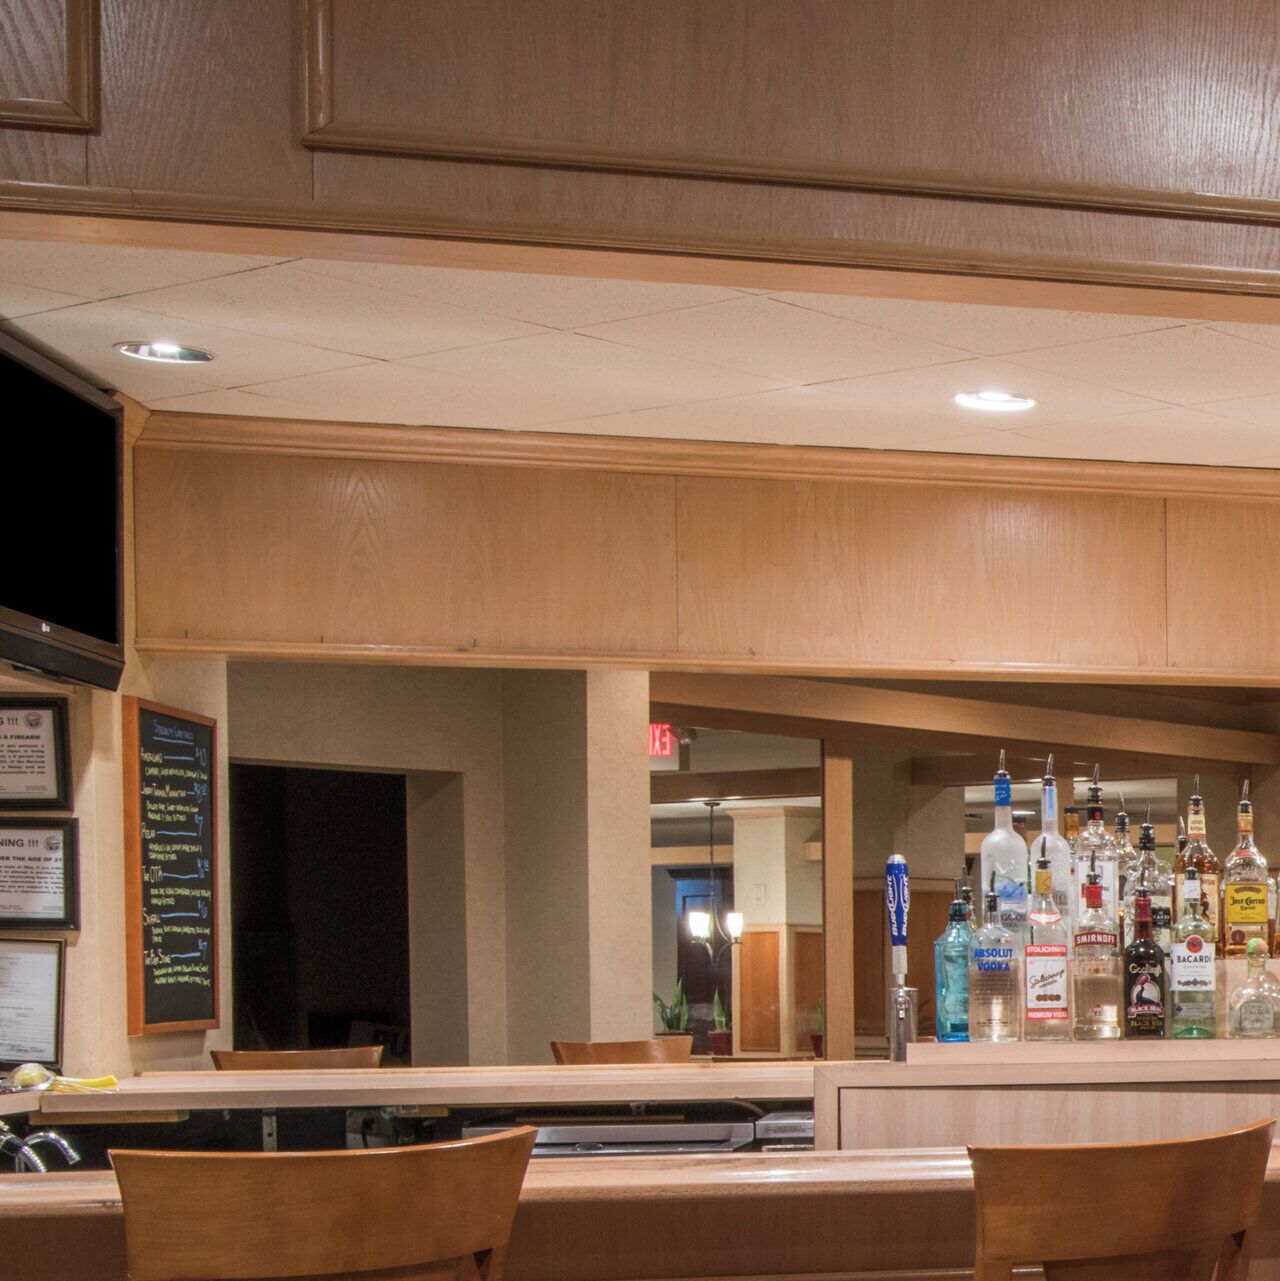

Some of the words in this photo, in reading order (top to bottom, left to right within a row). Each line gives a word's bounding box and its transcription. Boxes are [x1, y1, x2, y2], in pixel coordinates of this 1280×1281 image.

[1076, 933, 1116, 945] SMIRNOFF
[974, 948, 1013, 958] ABSOLUT
[977, 961, 1010, 971] VODKA
